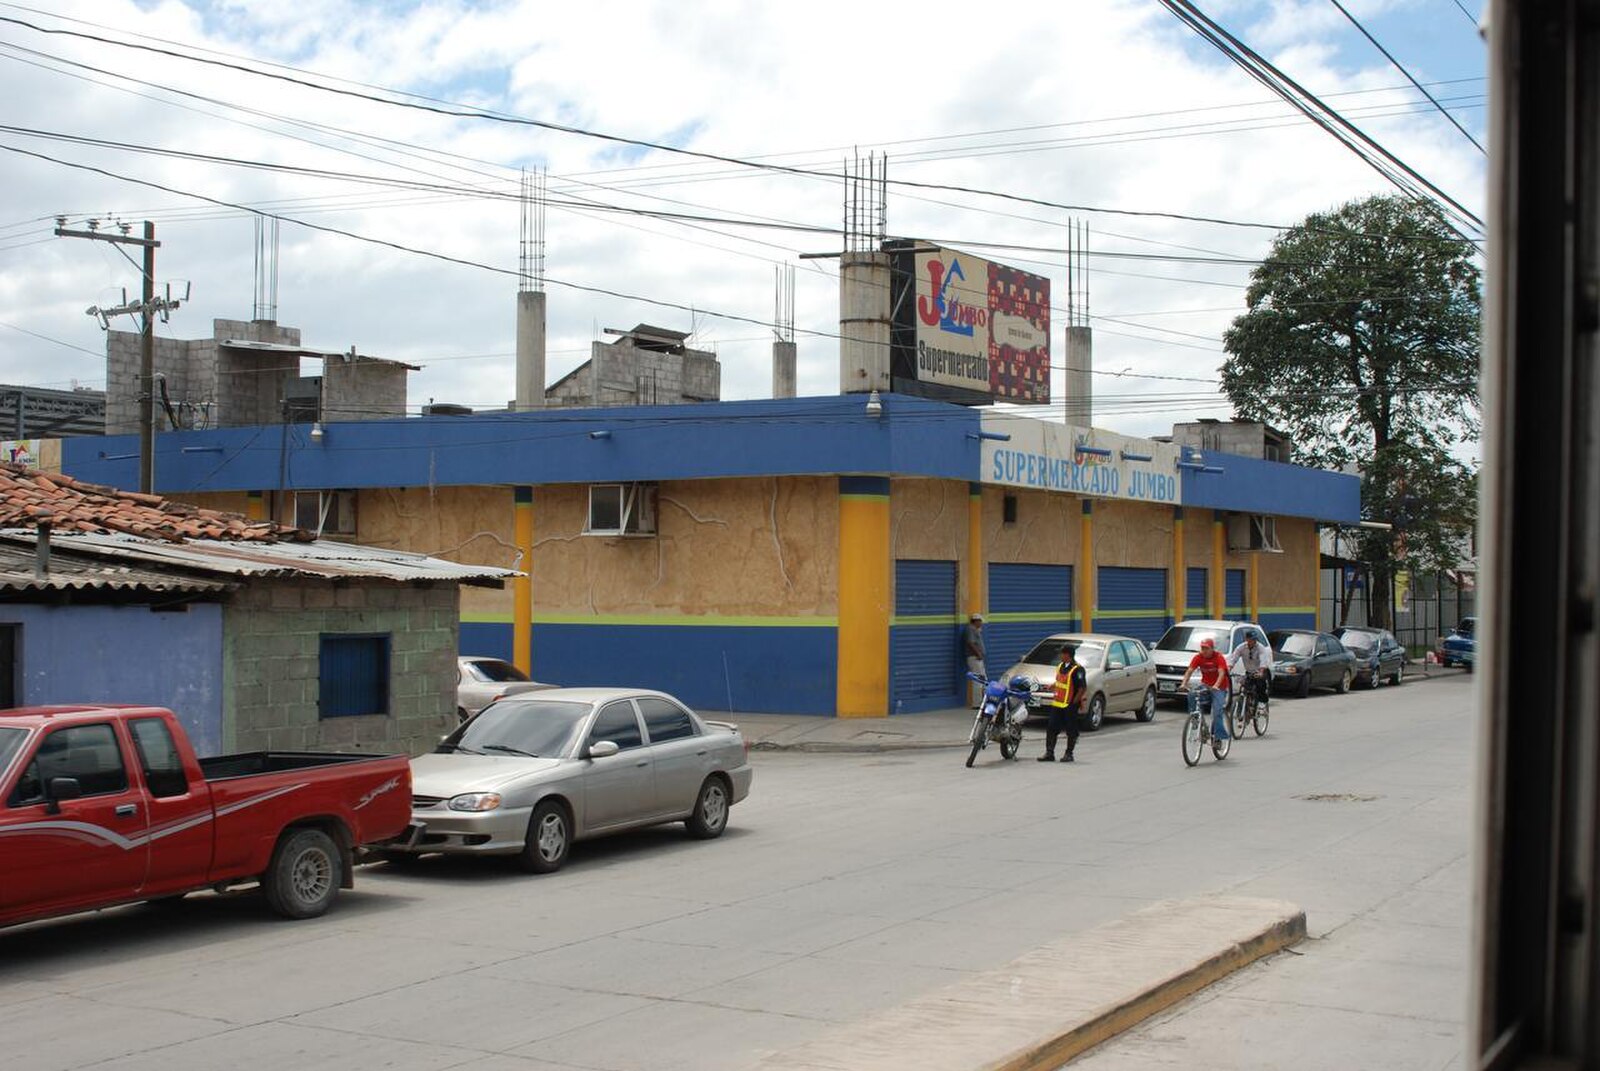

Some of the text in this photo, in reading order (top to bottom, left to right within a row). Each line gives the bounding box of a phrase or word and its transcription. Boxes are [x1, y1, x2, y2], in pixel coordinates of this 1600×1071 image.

[919, 340, 988, 381] Supermercado
[993, 449, 1119, 495] SUPERMERCADO
[1128, 470, 1176, 501] JUMBO
